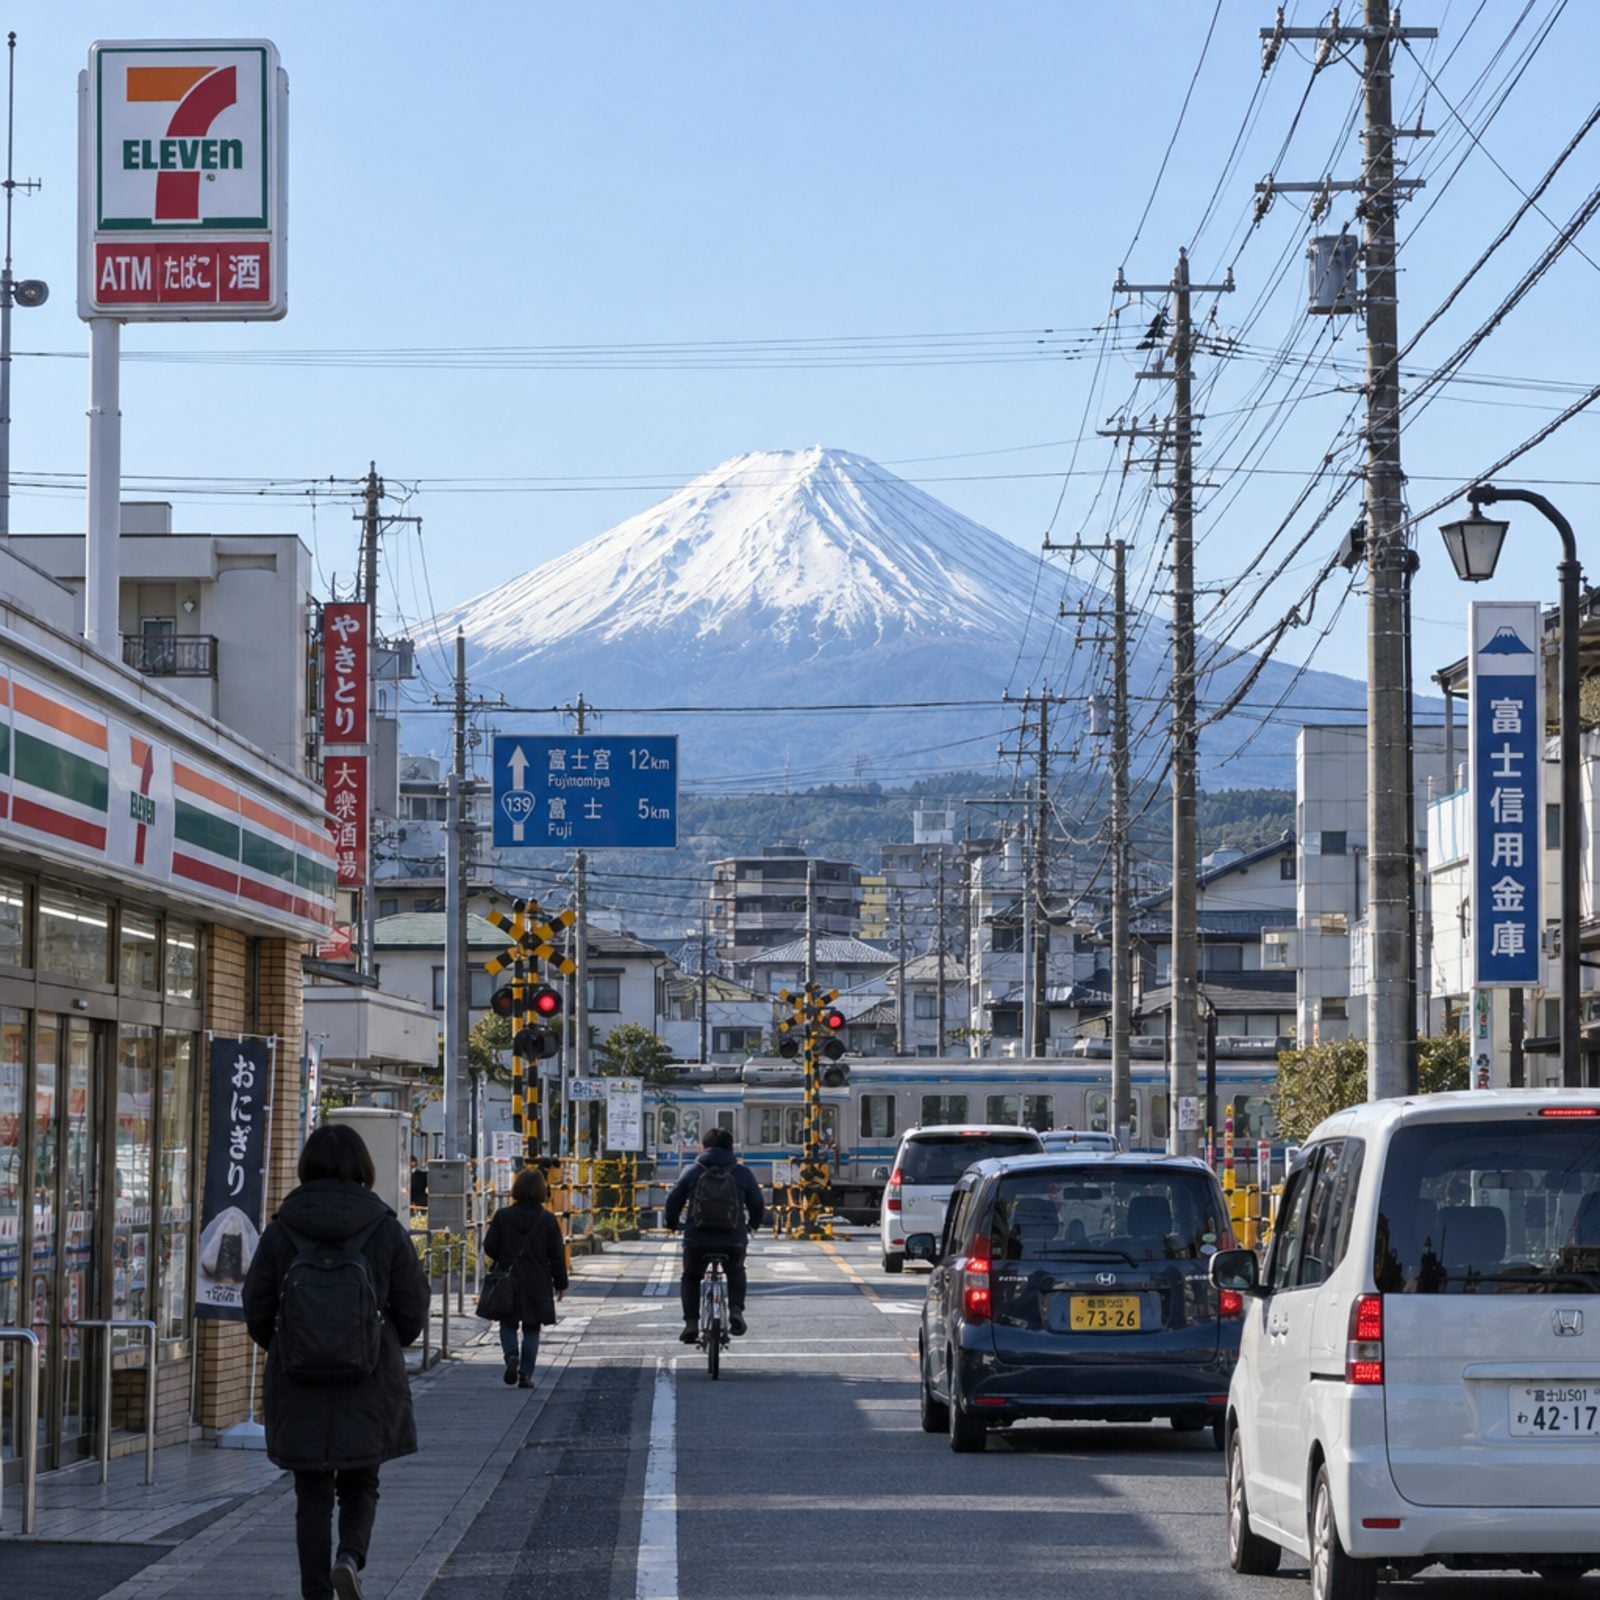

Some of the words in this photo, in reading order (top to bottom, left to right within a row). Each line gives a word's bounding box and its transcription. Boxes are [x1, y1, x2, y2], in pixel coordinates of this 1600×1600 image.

[126, 65, 237, 220] 7
[100, 256, 151, 291] ATM
[164, 254, 212, 289] たばこ
[229, 254, 261, 290] 酒
[330, 614, 361, 736] やきとり
[548, 748, 611, 770] 富士宮
[629, 749, 670, 770] 12km
[506, 797, 532, 812] 139
[548, 797, 603, 820] 富士
[638, 798, 670, 820] 5km
[548, 822, 573, 839] Fuji
[1489, 697, 1526, 958] 富士信用金庫
[227, 1054, 256, 1197] おにぎり
